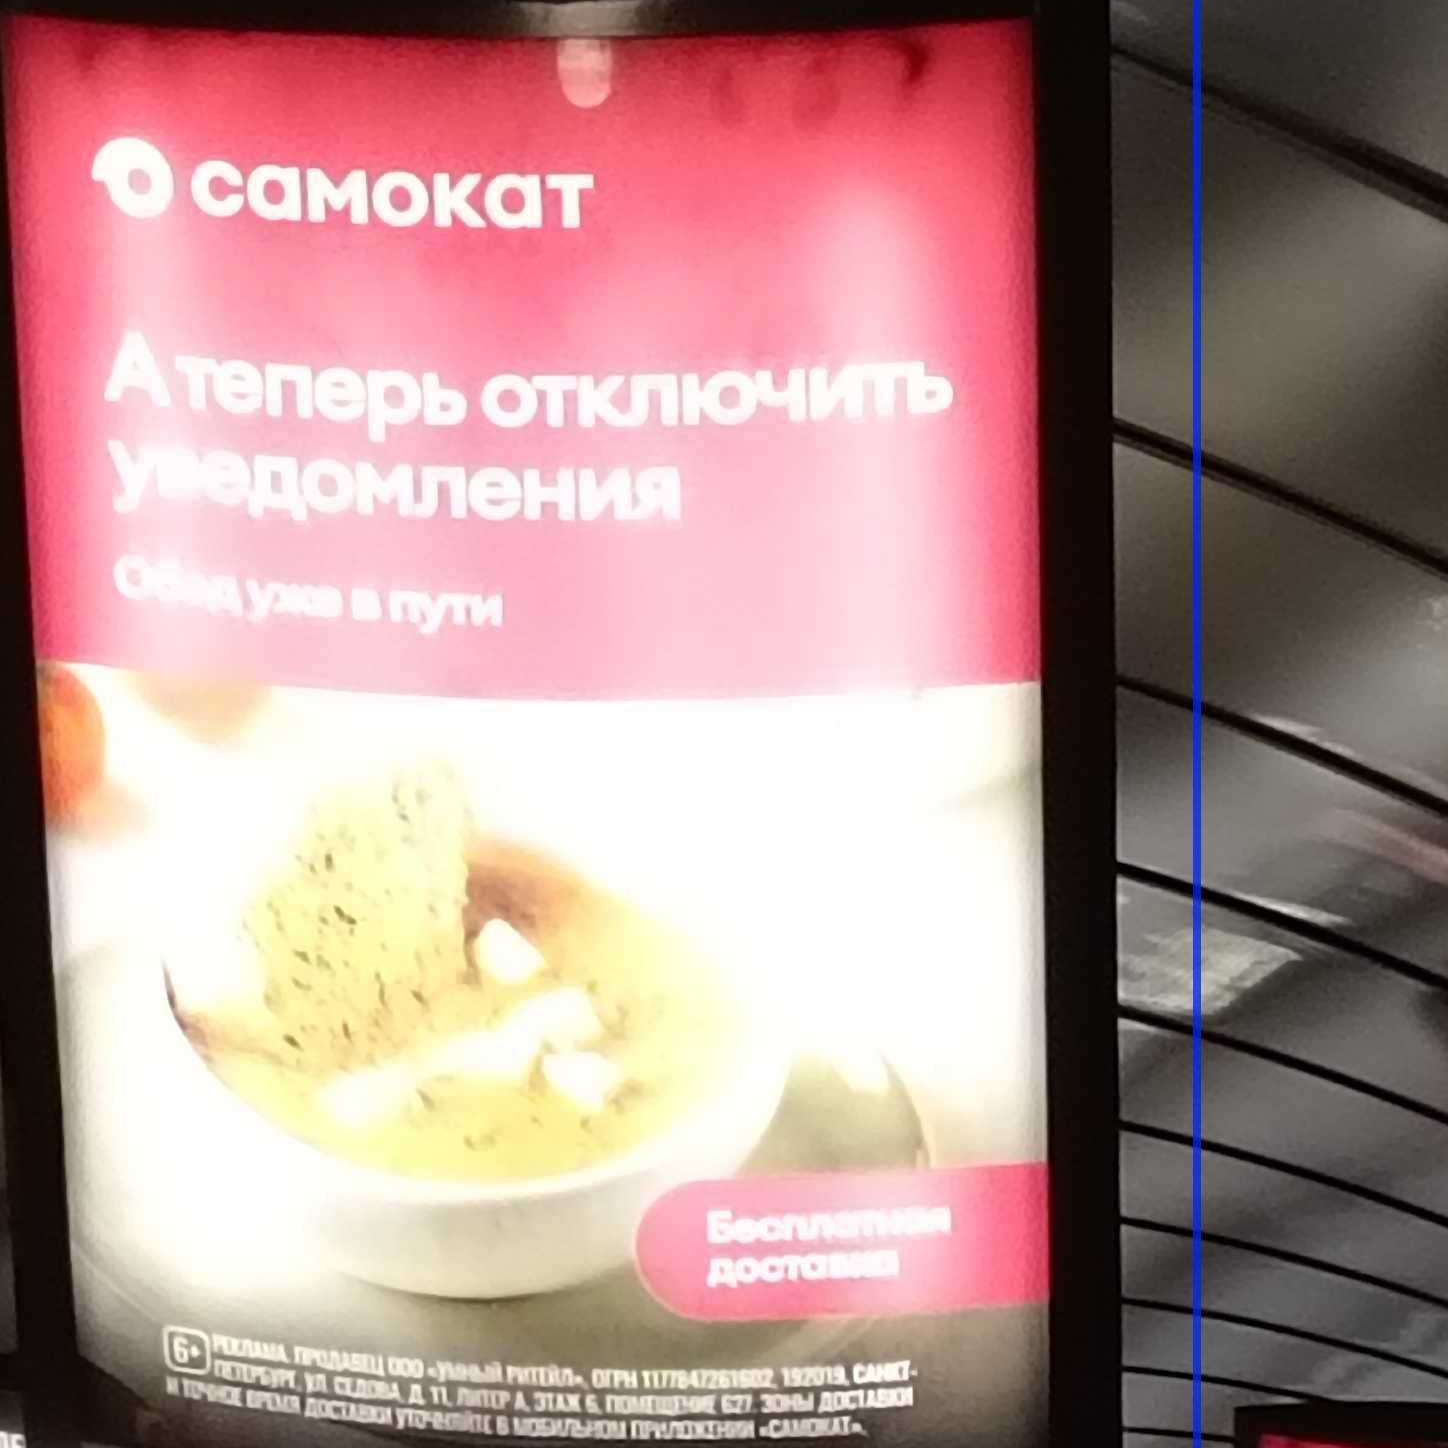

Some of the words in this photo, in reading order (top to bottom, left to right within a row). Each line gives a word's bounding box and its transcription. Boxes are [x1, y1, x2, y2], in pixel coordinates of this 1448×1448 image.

[189, 157, 595, 230] самокат
[103, 330, 173, 408] А
[177, 350, 468, 442] теперь
[480, 359, 955, 430] отключить
[106, 438, 683, 523] уведомления
[245, 578, 342, 623] уже
[389, 590, 503, 635] пути
[706, 1206, 952, 1244] Бесплатная
[706, 1248, 901, 1288] доставка
[387, 1355, 425, 1379] ООО
[591, 1368, 638, 1389] ОГРН
[852, 1359, 919, 1384] САНКТ-
[304, 1397, 393, 1425] ДОСТАВКИ
[496, 1415, 510, 1436] В
[513, 1416, 627, 1439] МОБИЛЬНОМ
[630, 1419, 756, 1439] ПРИЛОЖЕНИИ
[533, 1391, 582, 1413] ЭТАЖ
[760, 1391, 815, 1414] ЗОНЫ
[817, 1386, 914, 1415] ДОСТАВКИ
